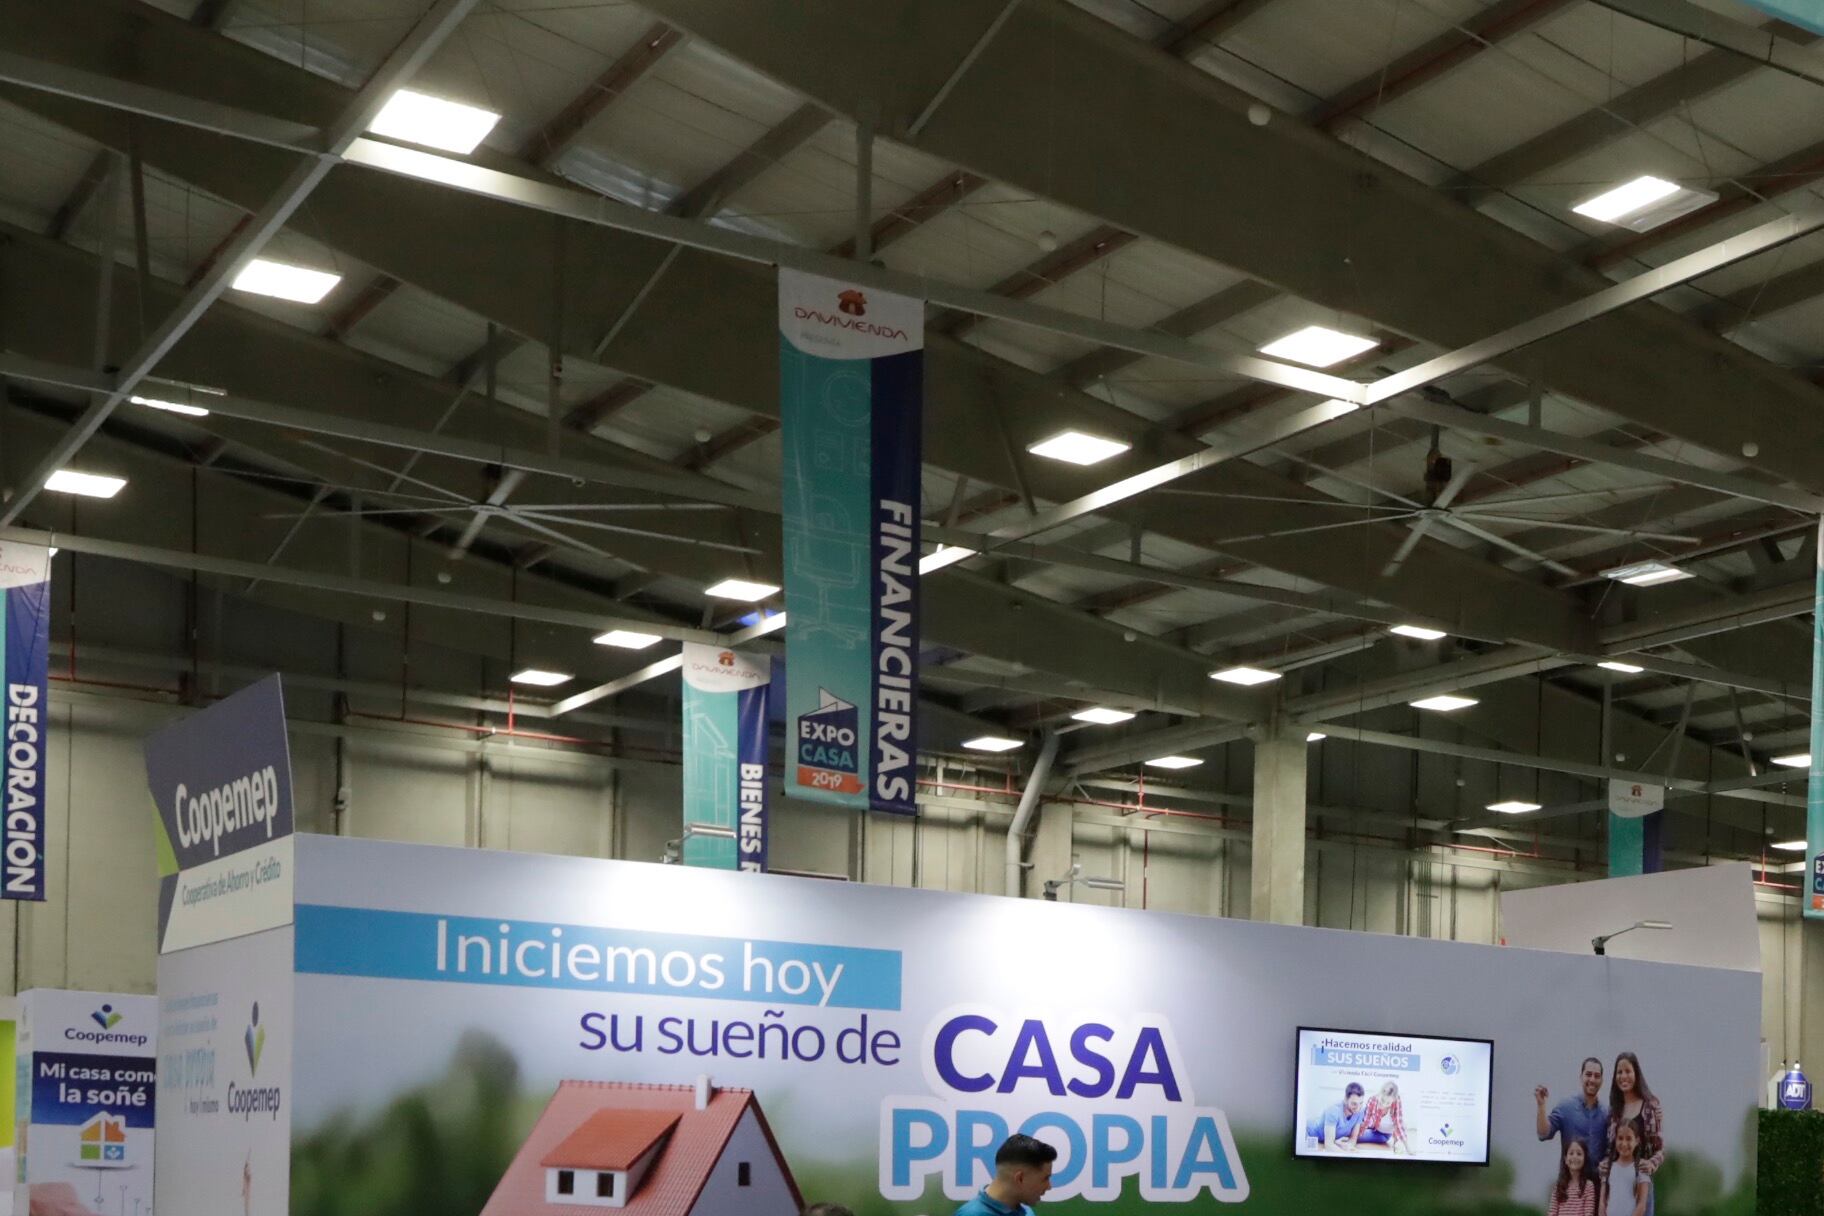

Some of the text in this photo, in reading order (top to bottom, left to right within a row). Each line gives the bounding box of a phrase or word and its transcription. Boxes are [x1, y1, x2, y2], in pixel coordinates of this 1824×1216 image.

[794, 307, 908, 341] DAVIVIENDA
[876, 498, 914, 802] FINANCIERAS
[800, 720, 855, 746] EXPO
[801, 743, 854, 768] CASA
[6, 683, 43, 894] DECORACIÓN
[811, 772, 842, 789] 2019
[175, 764, 279, 856] Coopemep
[740, 763, 764, 855] BIENES
[436, 919, 844, 1008] Iniciemos hoy
[64, 1027, 147, 1047] Coopemep
[579, 1010, 901, 1065] su sueño de
[1372, 1043, 1412, 1053] realidad
[40, 1062, 66, 1079] Mi
[69, 1066, 111, 1081] casa
[933, 1014, 1182, 1102] CASA
[1327, 1051, 1409, 1068] SUS SUEÑOS
[59, 1082, 147, 1106] la soñé
[227, 1081, 280, 1122] Coopemep
[1785, 1083, 1807, 1099] ADT
[892, 1107, 1238, 1191] PROPIA
[1428, 1136, 1464, 1147] Coopemep
